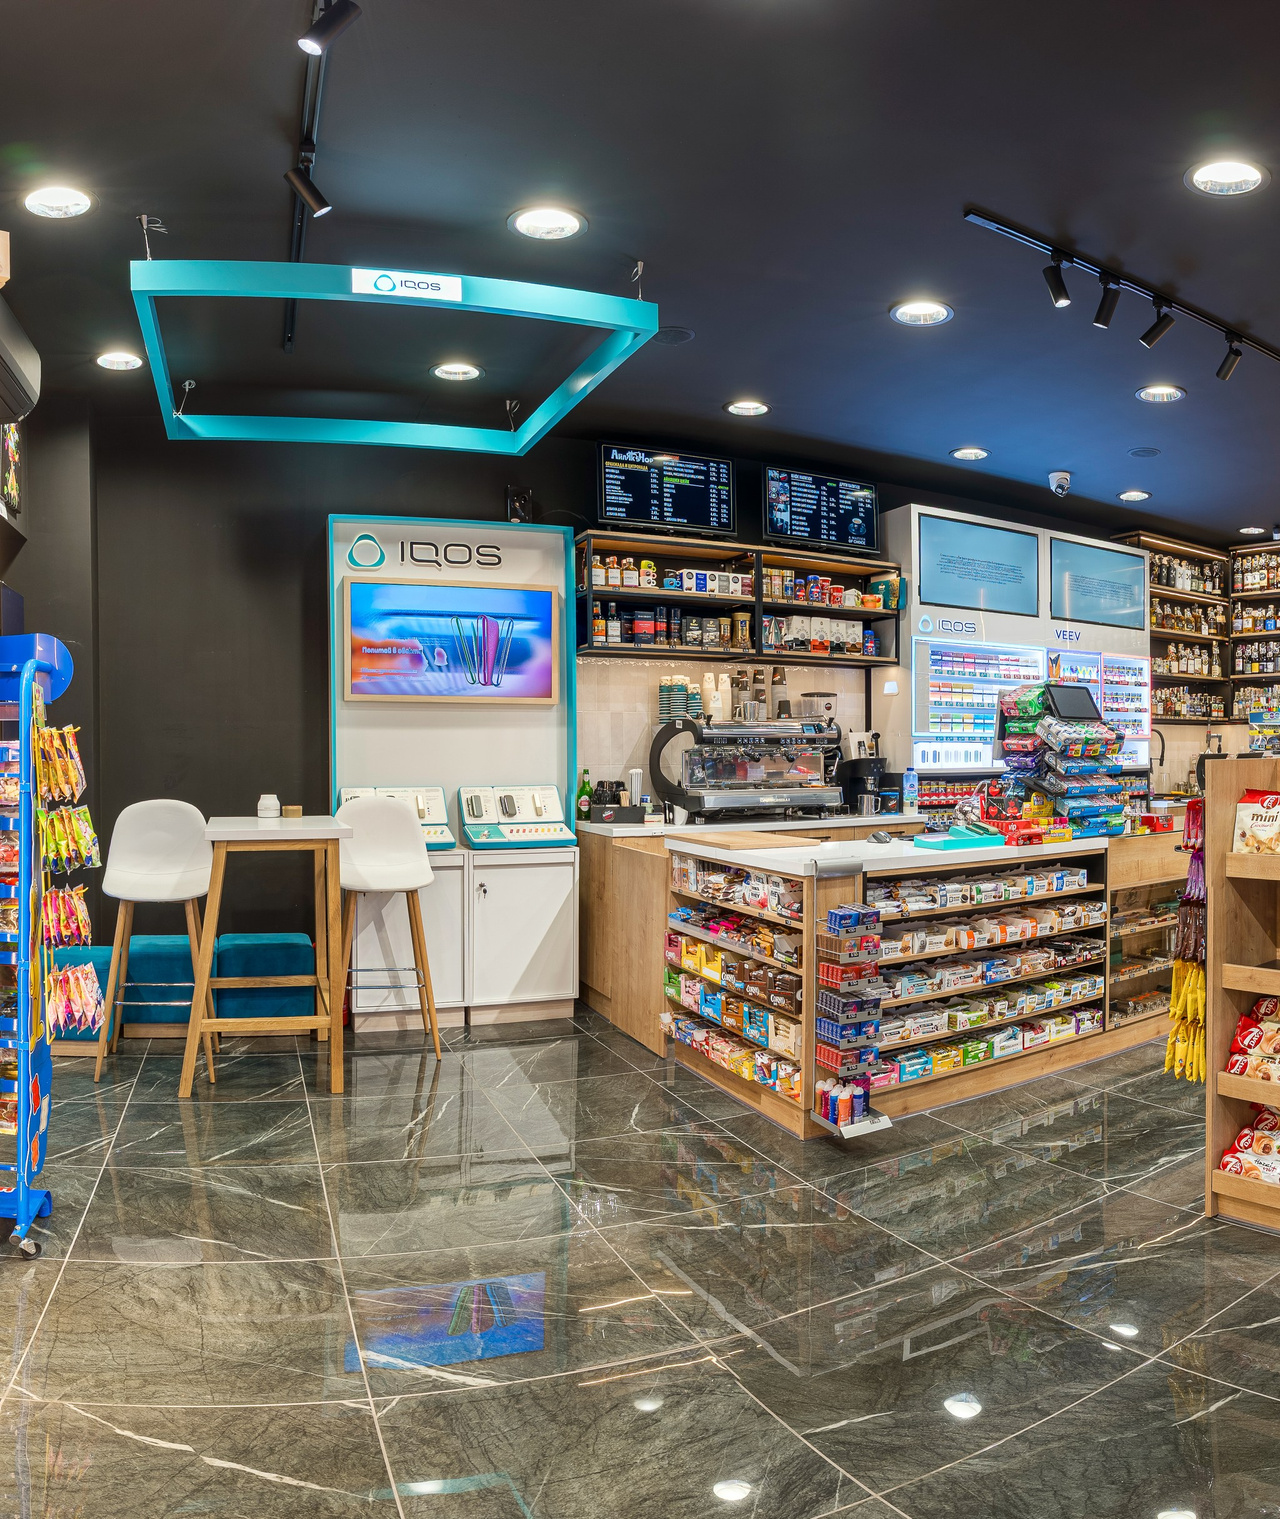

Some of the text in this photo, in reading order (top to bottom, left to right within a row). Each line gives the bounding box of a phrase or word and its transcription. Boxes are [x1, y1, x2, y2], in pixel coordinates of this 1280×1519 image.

[400, 279, 441, 291] IQOS
[400, 541, 502, 568] IQOS
[937, 619, 977, 633] IQOS
[1055, 629, 1081, 641] VEEV
[1251, 810, 1280, 822] mini
[1250, 1029, 1264, 1047] DAYS
